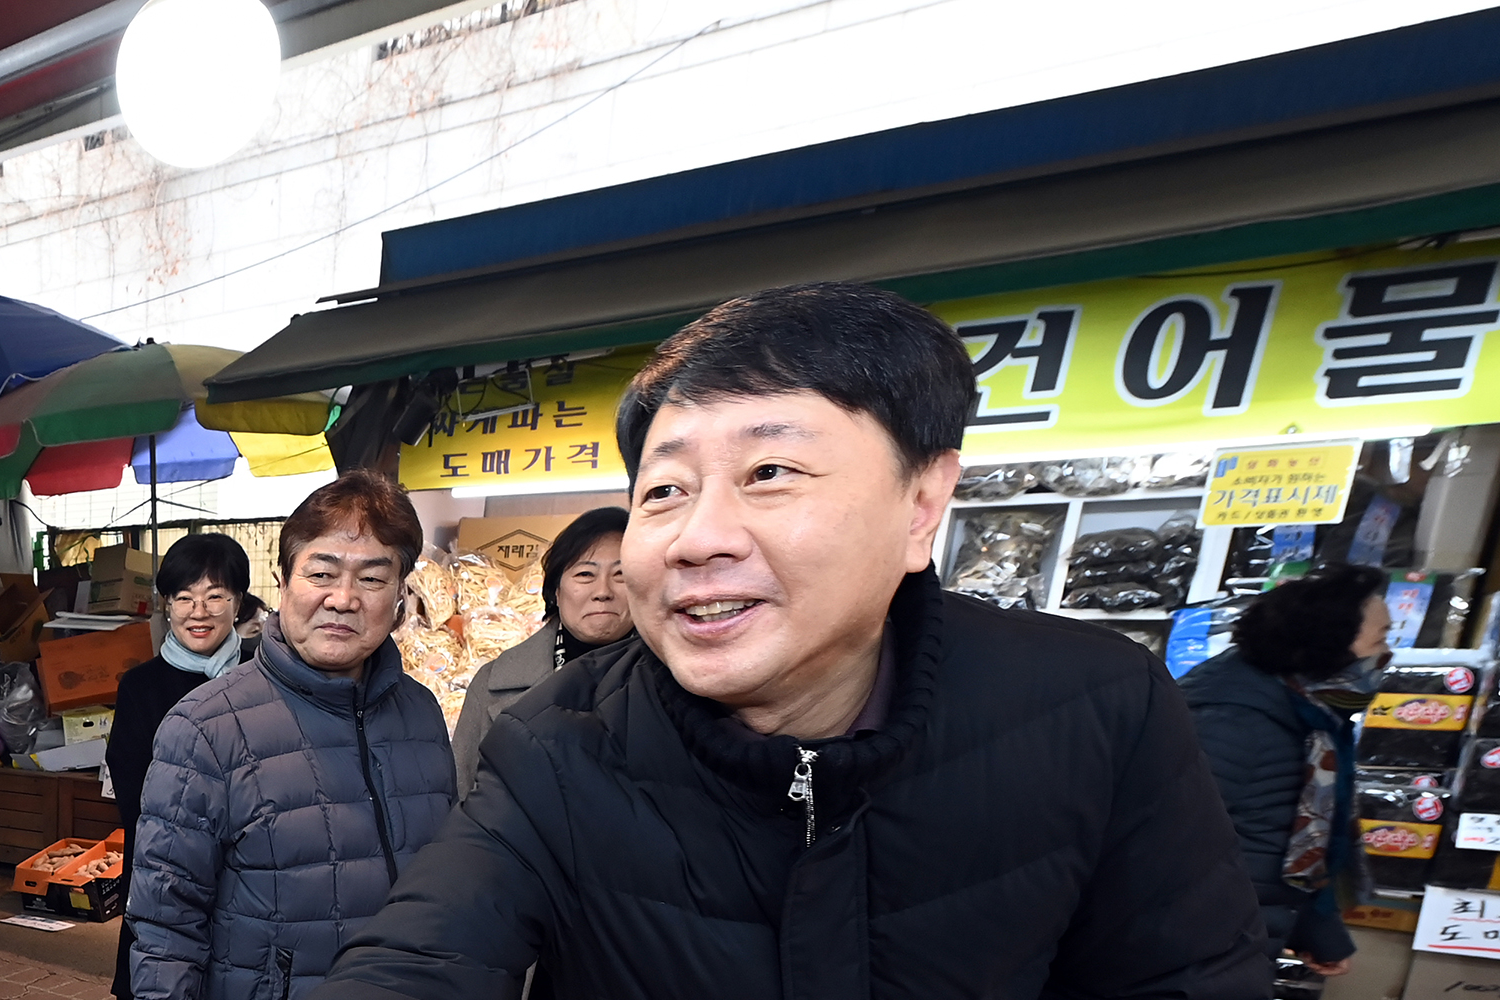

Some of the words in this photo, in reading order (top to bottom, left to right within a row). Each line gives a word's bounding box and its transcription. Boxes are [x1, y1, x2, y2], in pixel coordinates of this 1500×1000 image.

[957, 261, 1500, 428] 건어물
[441, 442, 599, 478] 도매가격
[1213, 484, 1338, 508] 가격표시제
